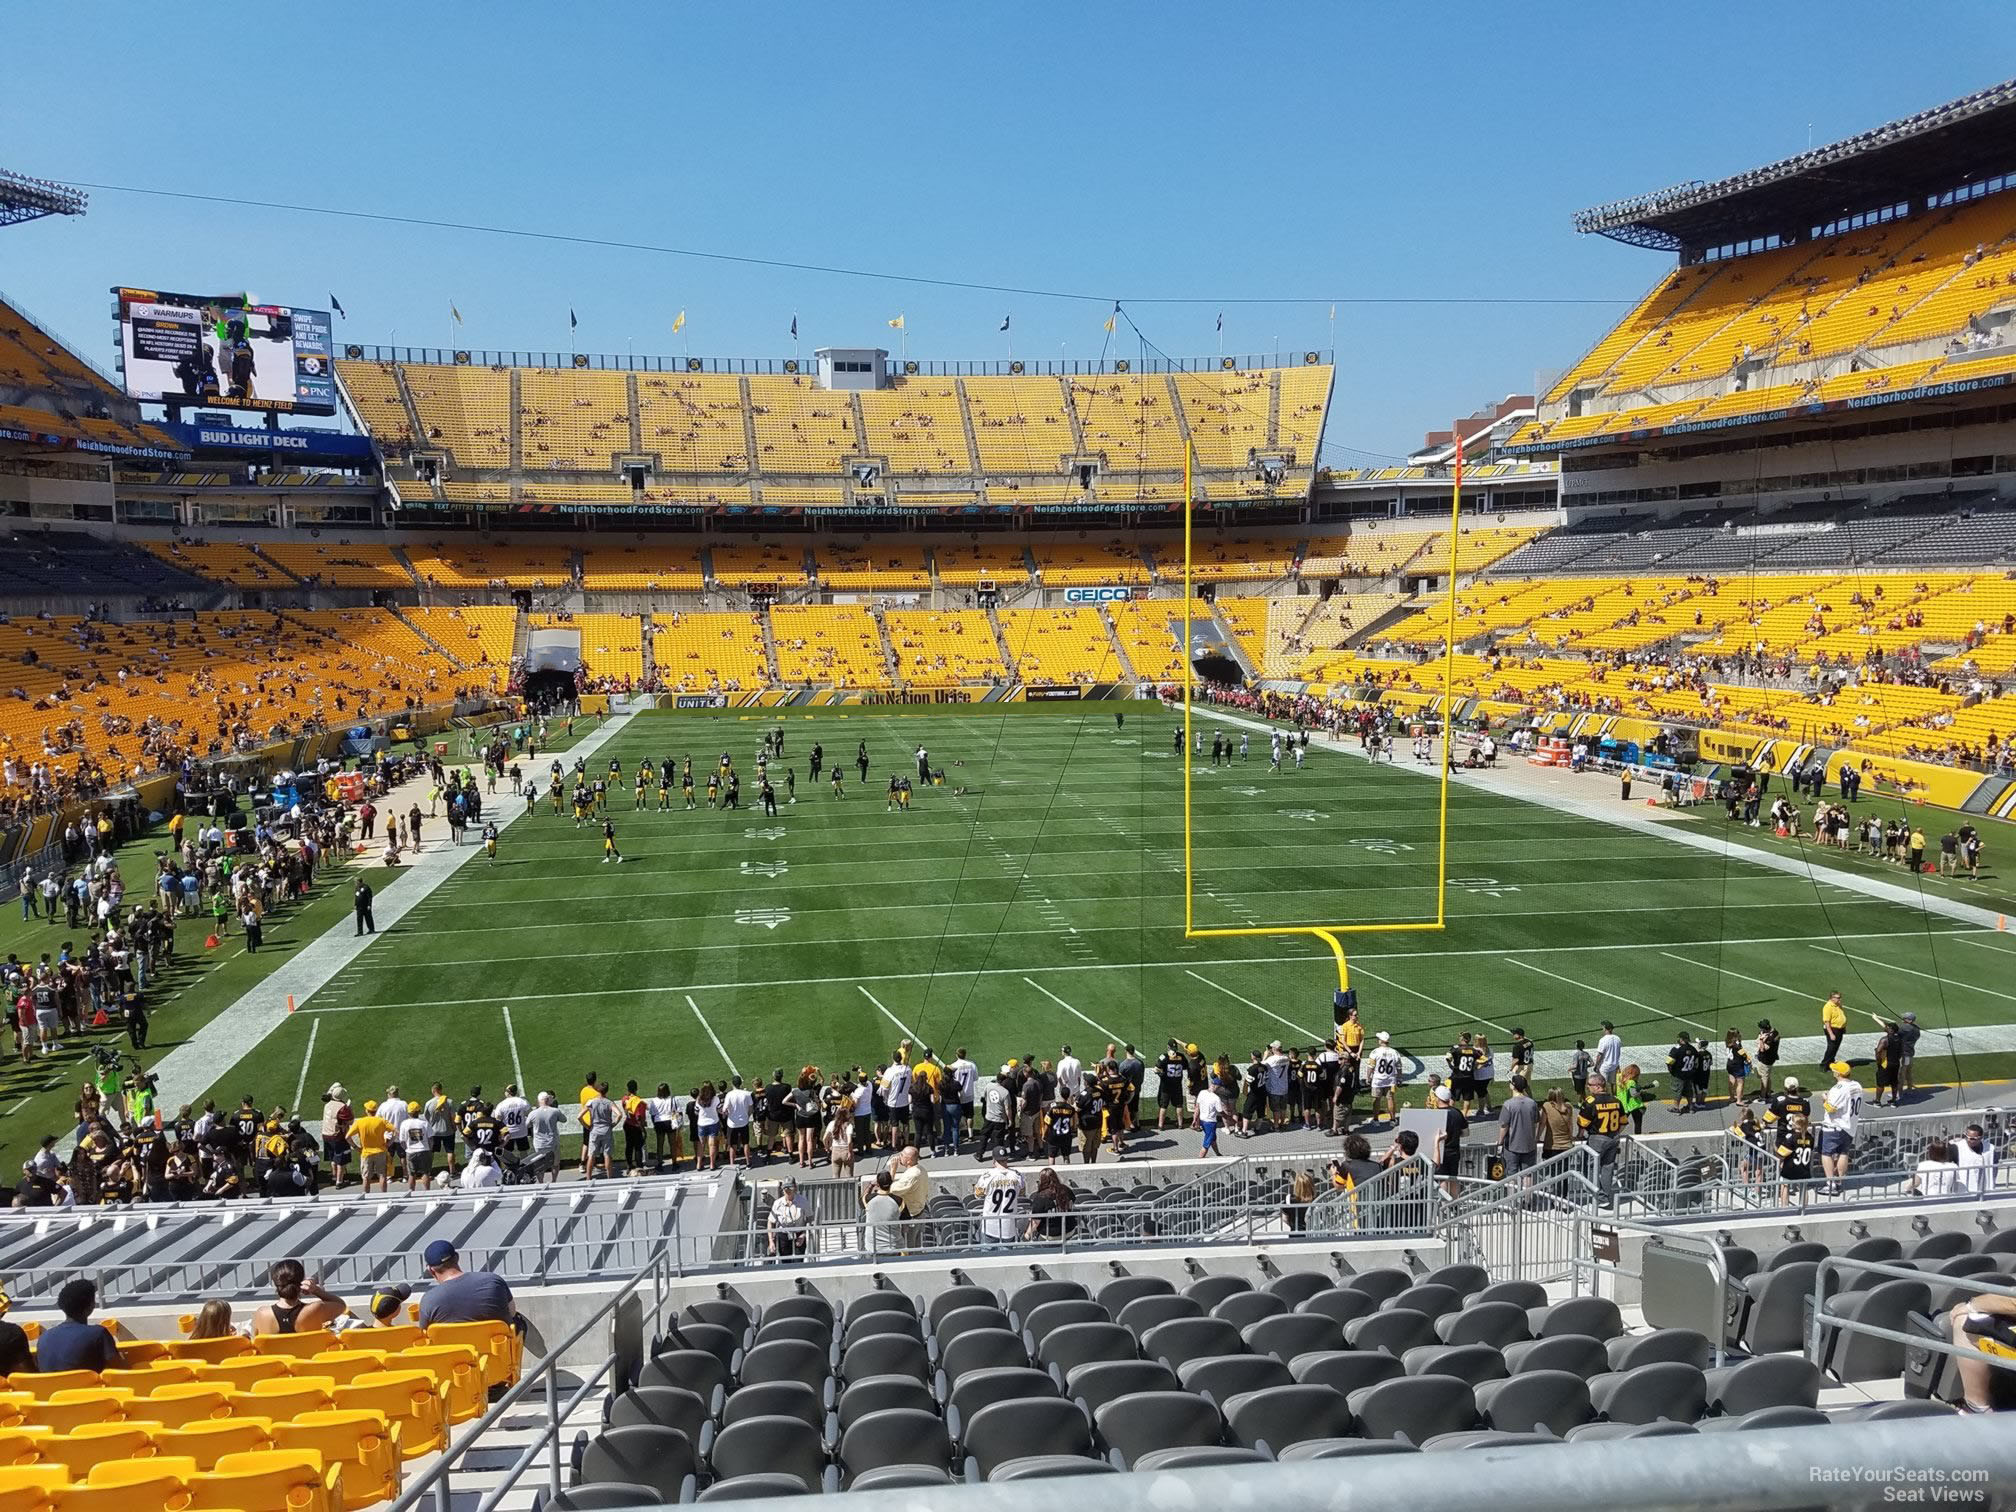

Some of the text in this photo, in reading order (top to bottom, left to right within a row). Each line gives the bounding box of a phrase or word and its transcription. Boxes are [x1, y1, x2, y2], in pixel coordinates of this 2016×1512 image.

[153, 309, 194, 320] WARMUPS
[311, 387, 330, 397] PNC
[1846, 375, 2005, 409] NeighborhoodFordStore.com
[207, 395, 293, 410] WELCOME TO HEINZ FIELD
[201, 431, 308, 448] BUD LIGHT DECK
[76, 439, 192, 461] NeighborhoodFordStore.com
[1322, 472, 1352, 481] Steelers
[560, 504, 705, 514] NeighborhoodFordStore.com
[804, 506, 939, 515] NeighborhoodFordStore.com
[1034, 503, 1166, 513] NeighborhoodFordStore.com
[749, 583, 776, 593] 25:53
[1067, 588, 1129, 601] GEICO
[1167, 1063, 1183, 1078] 52
[1378, 1058, 1394, 1075] 86
[1458, 1056, 1473, 1072] 83
[1681, 1055, 1695, 1072] 26
[1278, 1064, 1286, 1079] 7
[1305, 1070, 1317, 1083] 10
[900, 1077, 907, 1094] 7
[961, 1072, 969, 1088] 7
[1112, 1089, 1121, 1104] 7
[507, 1111, 522, 1126] 86
[1597, 1110, 1620, 1133] 78
[238, 1121, 255, 1136] 30
[1053, 1118, 1070, 1135] 43
[181, 1129, 193, 1141] 26
[476, 1129, 493, 1144] 92
[1793, 1147, 1811, 1165] 30
[992, 1188, 1017, 1213] 92
